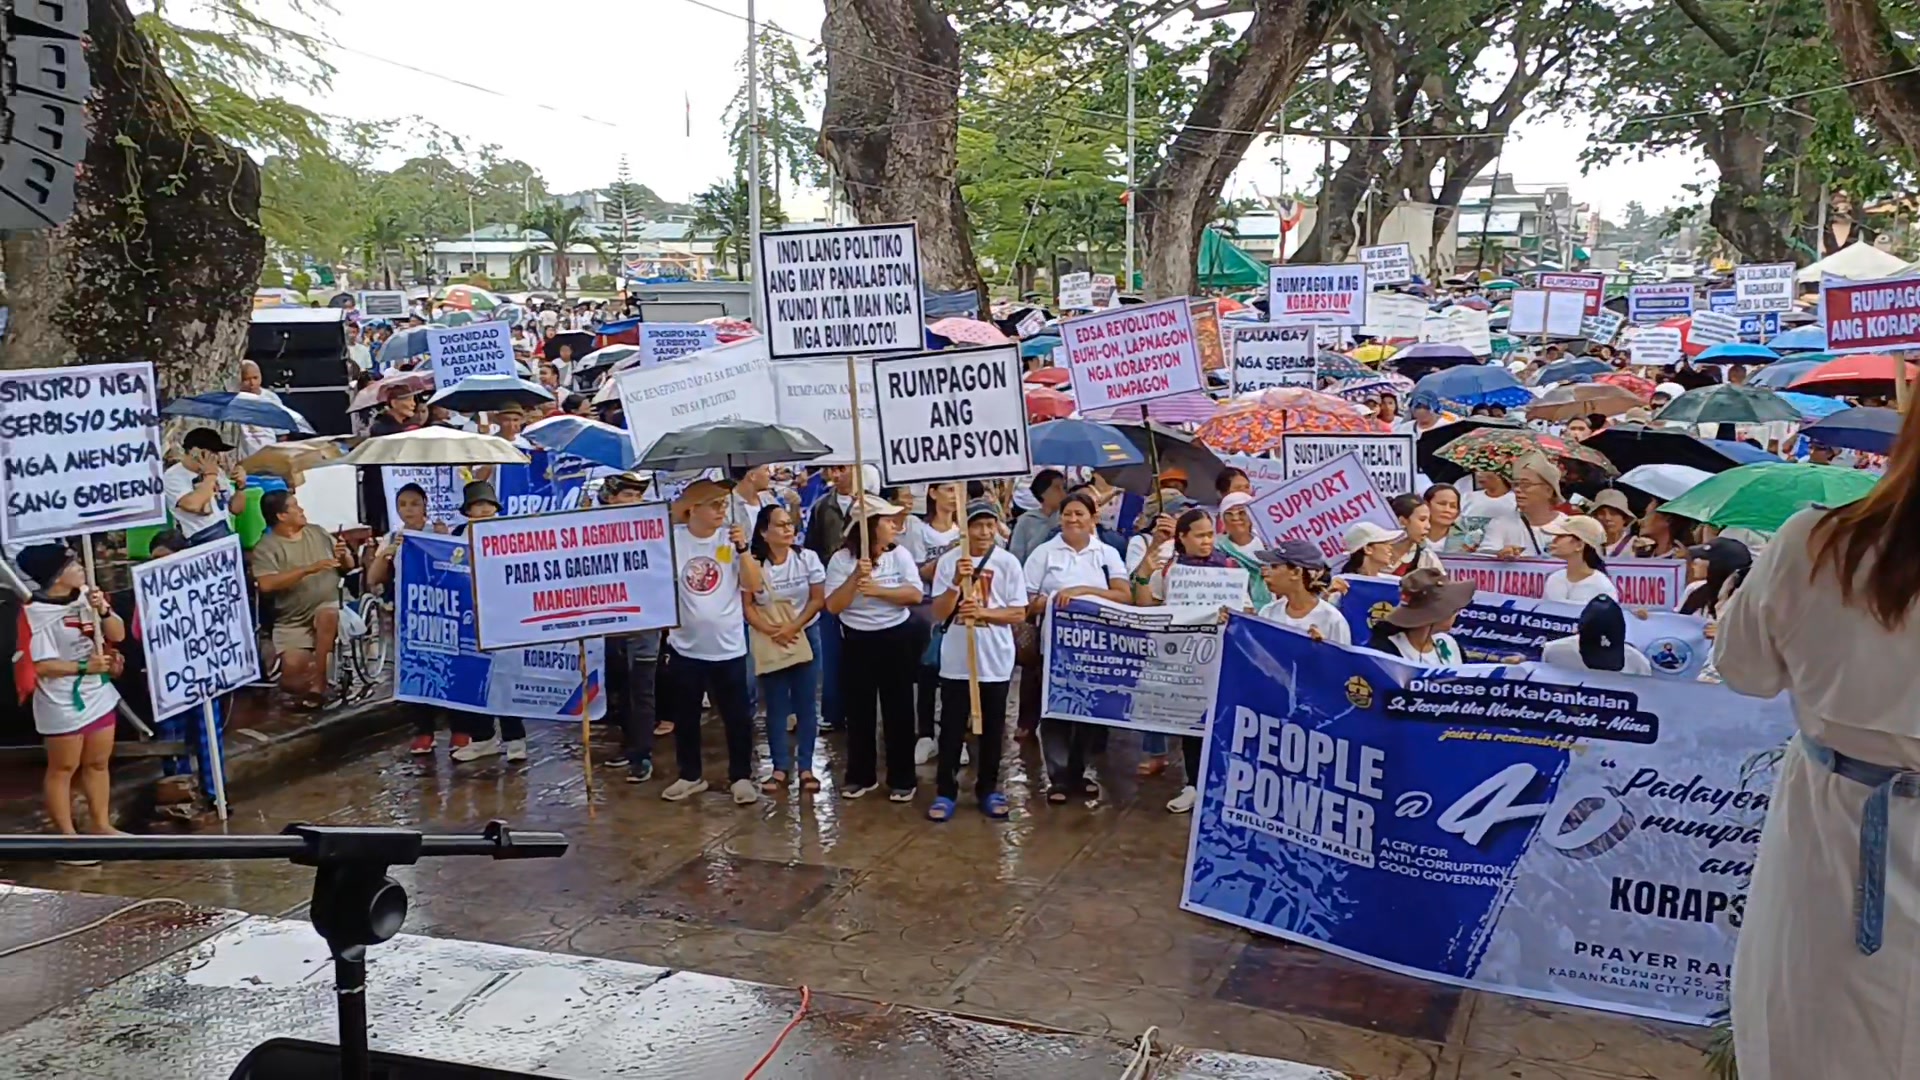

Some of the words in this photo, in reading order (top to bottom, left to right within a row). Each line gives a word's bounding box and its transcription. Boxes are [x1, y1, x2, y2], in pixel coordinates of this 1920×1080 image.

[776, 239, 804, 264] INDI
[806, 237, 840, 262] LANG
[844, 234, 902, 260] POLITIKO
[770, 269, 796, 293] ANG
[799, 267, 826, 291] MAY
[829, 263, 916, 291] PANALABTON,
[1276, 276, 1334, 293] RUMPAGON
[1338, 275, 1358, 291] ANG
[777, 297, 818, 322] KUNDI
[821, 295, 851, 319] KITA
[854, 293, 881, 318] MAN
[884, 292, 912, 316] NGA
[439, 329, 499, 345] DIGNIDAD
[793, 325, 822, 349] MGA
[824, 321, 897, 348] BUMOLOTO!
[1076, 325, 1105, 343] EDSA
[1106, 309, 1177, 337] REVOLUTION
[1832, 317, 1863, 341] ANG
[1867, 313, 1920, 338] KORAP
[441, 353, 484, 367] KABAN
[486, 350, 505, 361] NG
[1072, 342, 1124, 364] BUHI-ON,
[1125, 328, 1189, 355] LAPNAGON
[453, 362, 496, 376] BAYAN
[1087, 365, 1112, 382] NGA
[1114, 351, 1182, 377] KORAPSYON
[1235, 356, 1262, 370] NGA
[100, 372, 147, 397] NGA
[888, 361, 1007, 399] RUMPAGON
[1106, 374, 1169, 399] RUMPAGON
[0, 410, 105, 439] SERBISYO
[930, 399, 973, 429] ANG
[890, 428, 1019, 465] KURAPSYON
[1362, 444, 1402, 466] HEALTH
[4, 453, 58, 480] MGA
[7, 489, 67, 517] SANG
[73, 476, 163, 508] GOBIERNO
[1267, 469, 1350, 524] SUPPORT
[481, 529, 557, 557] PROGRAMA
[561, 527, 578, 549] SA
[582, 518, 665, 546] AGRIKULTURA
[505, 562, 540, 585] PARA
[544, 559, 562, 581] SA
[565, 552, 620, 579] GAGMAY
[624, 549, 649, 572] NGA
[160, 595, 182, 620] SA
[188, 575, 241, 613] PWESTO
[407, 582, 460, 618] PEOPLE
[533, 582, 628, 612] MANGUNGUMA
[1616, 575, 1666, 606] SALONG
[147, 610, 197, 653] HINDI
[202, 599, 240, 636] DAPAT
[407, 612, 460, 647] POWER
[1500, 612, 1517, 624] of
[1056, 625, 1108, 650] PEOPLE
[1110, 631, 1158, 658] POWER
[1181, 634, 1218, 665] 40
[1073, 652, 1124, 666] TRILLION
[165, 666, 197, 692] DO
[1065, 664, 1111, 677] DIOCESE
[1113, 668, 1128, 677] OF
[184, 670, 236, 704] STEAL
[1409, 680, 1486, 695] Diocese
[1490, 683, 1511, 698] of
[1514, 685, 1630, 711] Kabankalan
[1408, 697, 1460, 716] Joseph
[1460, 701, 1485, 715] the
[1486, 702, 1545, 721] Worker
[1545, 708, 1599, 727] Parish
[1438, 727, 1476, 741] joins
[1476, 729, 1491, 740] in
[1231, 704, 1385, 800] PEOPLE
[1620, 768, 1770, 815] Padayon
[1224, 758, 1375, 851] POWER
[1395, 791, 1433, 818] @
[1436, 762, 1632, 858] 40
[1227, 810, 1284, 834] TRILLION
[1287, 829, 1318, 846] PESO
[1322, 841, 1370, 863] MARCH
[1380, 838, 1390, 847] A
[1391, 840, 1418, 851] CRY
[1420, 845, 1448, 858] FOR
[1379, 861, 1420, 878] GOOD
[1423, 870, 1518, 888] GOVERNANCE
[1610, 877, 1747, 928] KORAPS
[1574, 941, 1677, 970] PRAYER
[1548, 967, 1649, 990] KABANKALAN
[1655, 983, 1689, 996] CITY
[1601, 963, 1676, 984] February
